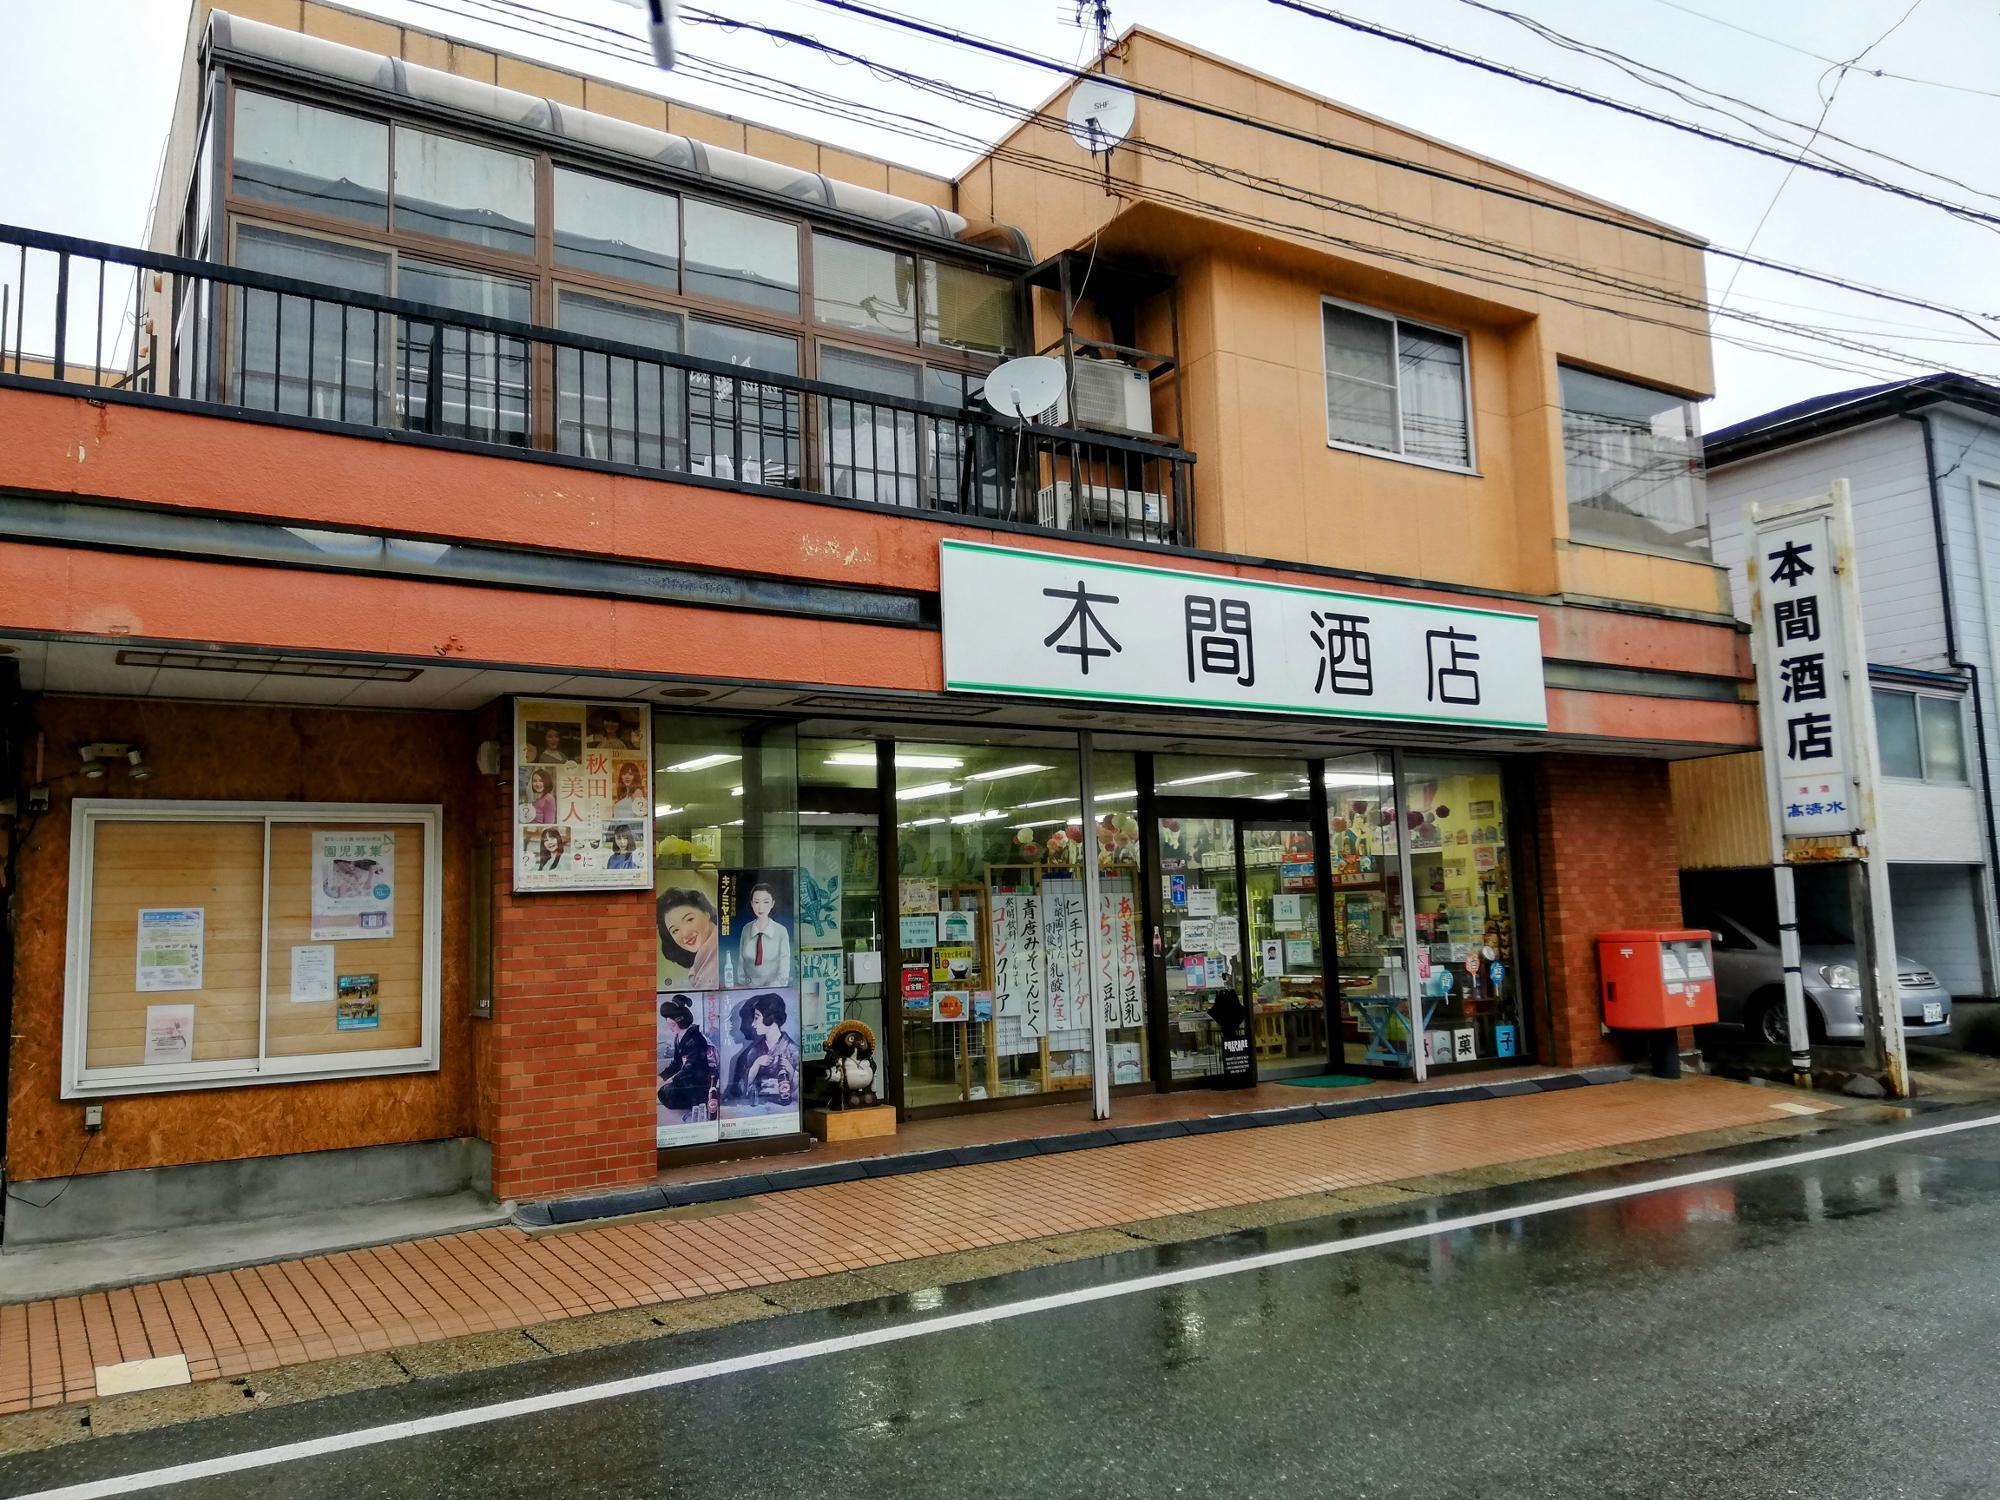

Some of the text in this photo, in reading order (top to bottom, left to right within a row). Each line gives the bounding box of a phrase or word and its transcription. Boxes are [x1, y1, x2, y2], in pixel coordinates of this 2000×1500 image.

[1043, 580, 1481, 706] 本間酒店
[1768, 541, 1833, 761] 本間酒店
[324, 845, 382, 857] 園児募集
[1021, 899, 1040, 1034] 青唐みそにんにく
[1066, 899, 1090, 1025] 仁手古サイダー
[1118, 896, 1142, 1024] あまおう豆乳
[1457, 1034, 1472, 1055] 菓
[1501, 1031, 1513, 1051] 子
